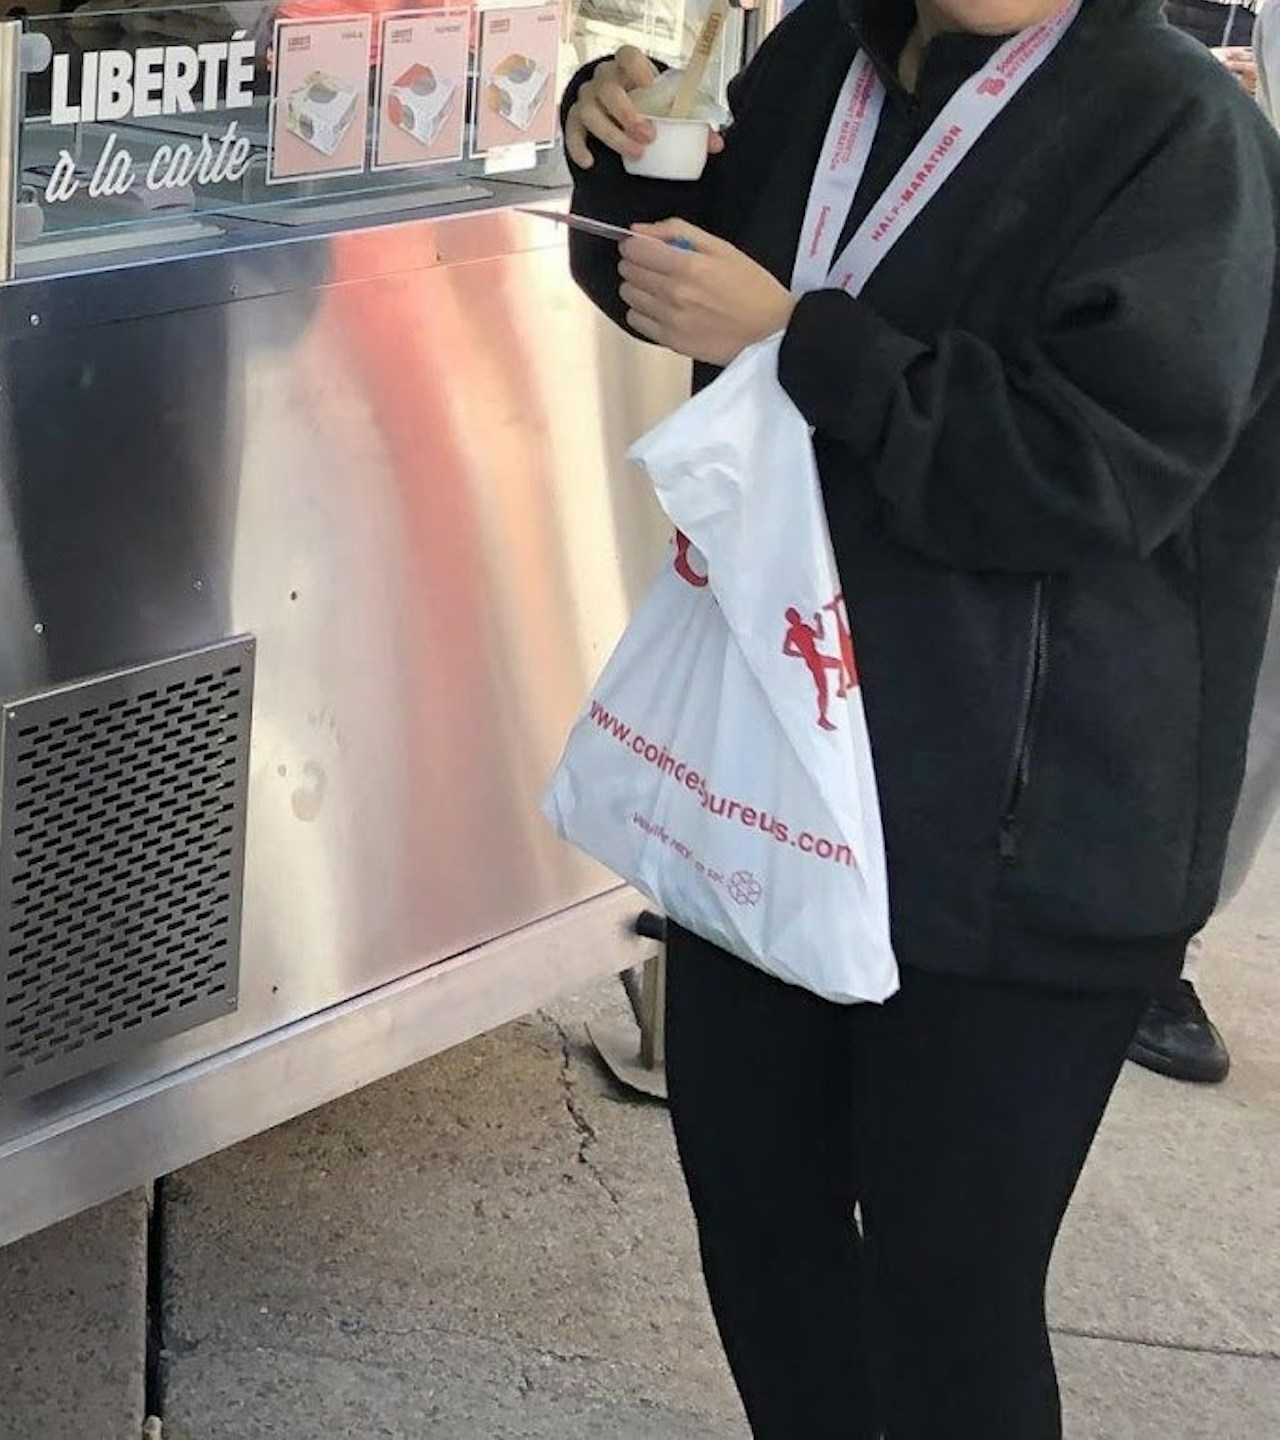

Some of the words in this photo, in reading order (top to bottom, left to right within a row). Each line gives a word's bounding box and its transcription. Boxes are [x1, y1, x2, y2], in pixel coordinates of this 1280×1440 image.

[51, 29, 255, 124] LIBERTÉ
[45, 149, 79, 203] à
[89, 133, 135, 197] la
[147, 121, 250, 190] carte
[872, 125, 962, 241] HALF-MARATHON
